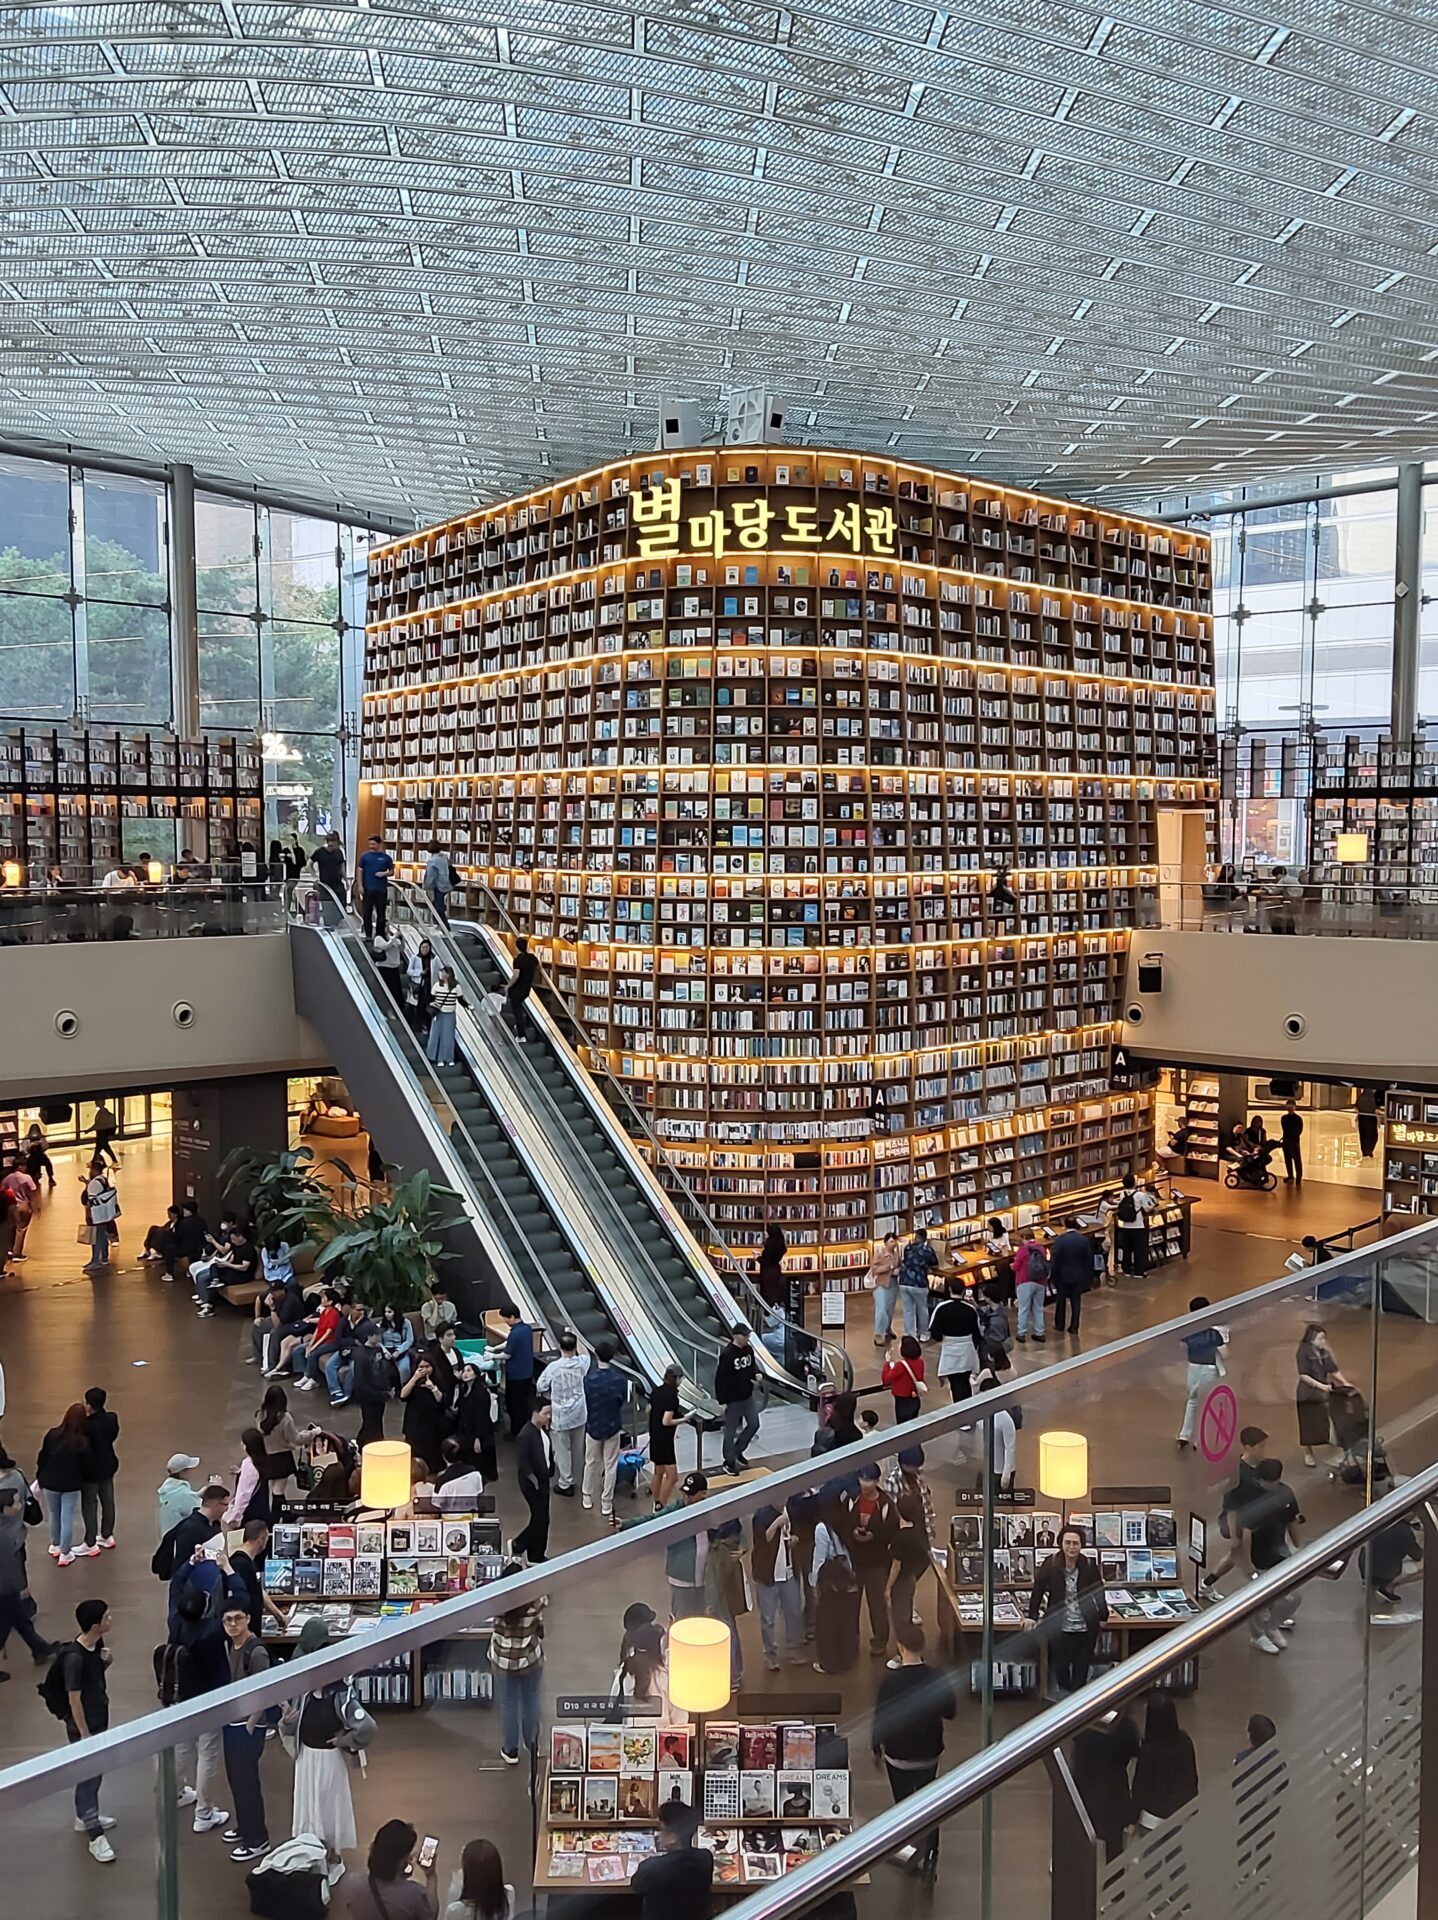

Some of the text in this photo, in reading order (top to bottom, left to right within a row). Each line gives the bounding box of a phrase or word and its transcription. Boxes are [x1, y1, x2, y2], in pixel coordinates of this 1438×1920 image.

[1115, 1051, 1126, 1066] A
[876, 1089, 884, 1105] A
[1392, 1123, 1438, 1144] 별마당도
[563, 1702, 579, 1710] D10
[815, 1773, 848, 1781] DREAMS
